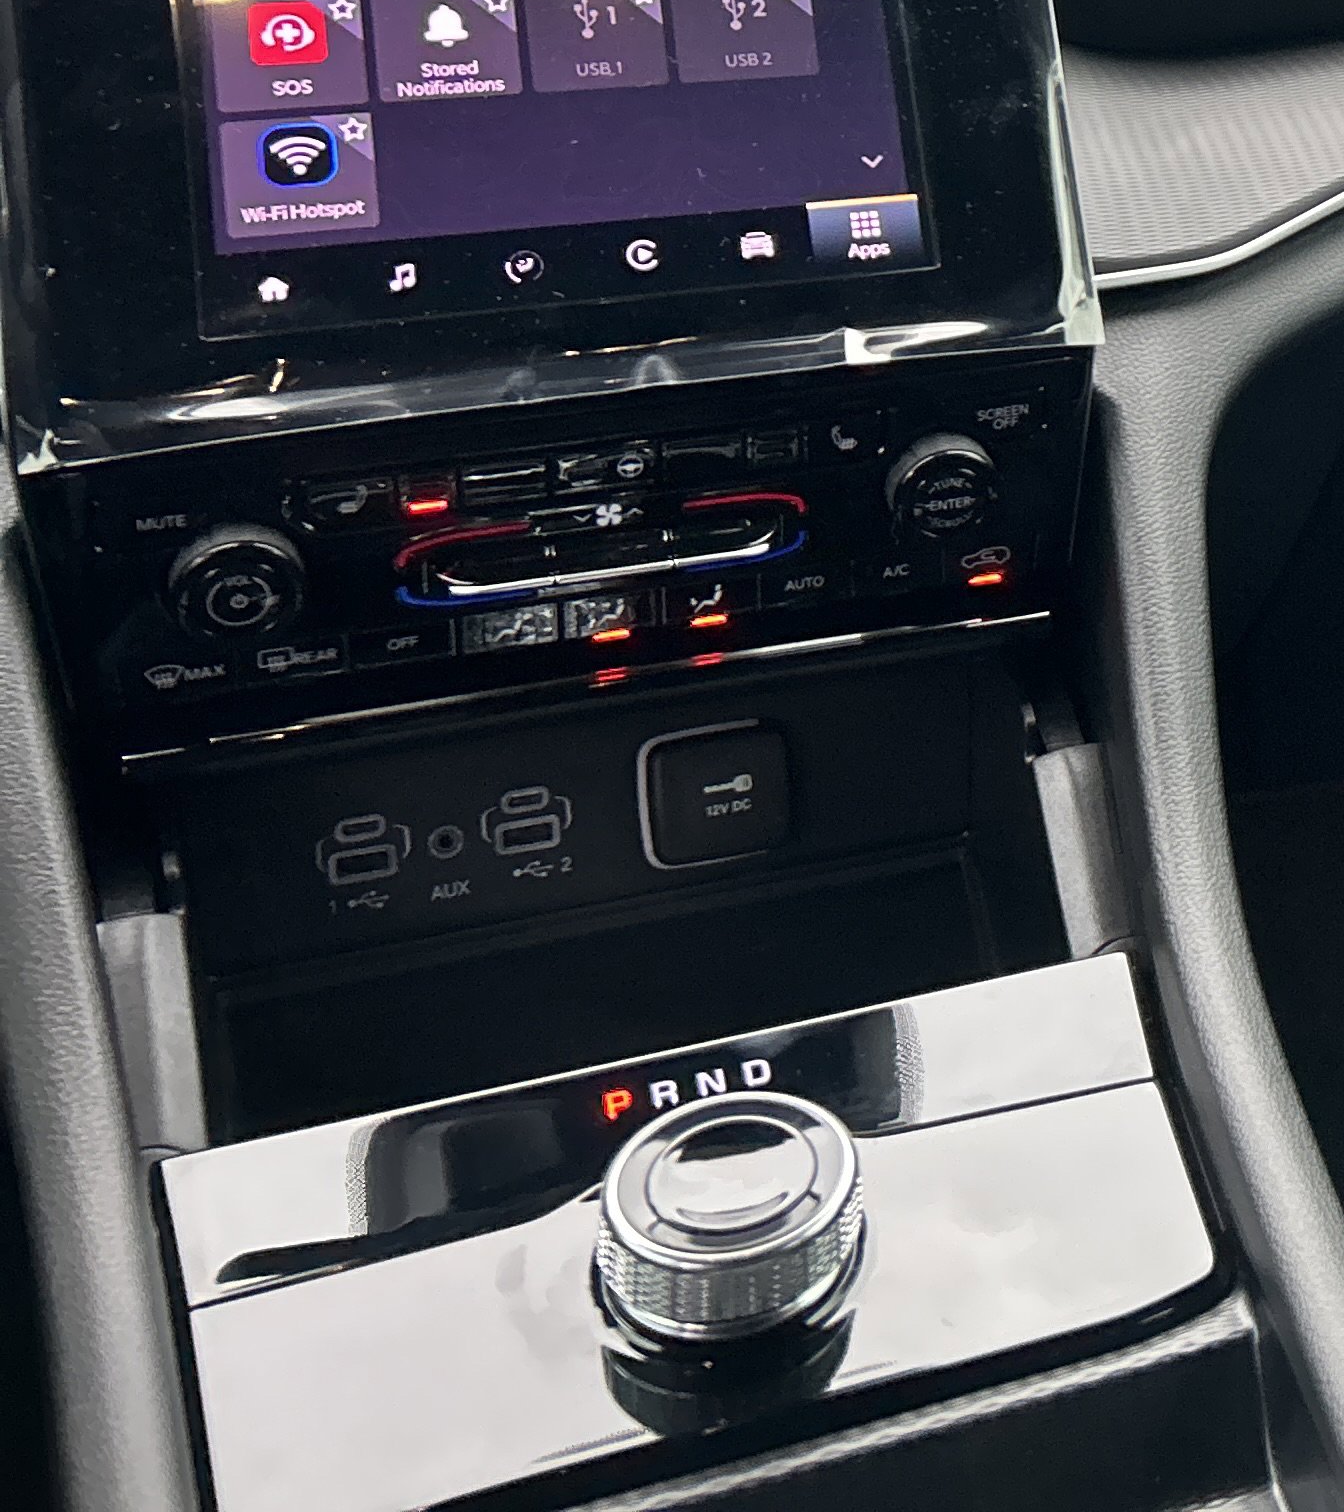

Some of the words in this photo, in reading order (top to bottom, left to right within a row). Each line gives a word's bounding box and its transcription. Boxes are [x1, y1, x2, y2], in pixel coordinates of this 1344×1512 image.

[420, 59, 480, 78] Stored
[575, 60, 612, 76] USB
[724, 52, 759, 69] USB
[760, 51, 773, 67] 2
[271, 79, 314, 98] SOS
[396, 77, 507, 99] Notifications
[240, 204, 290, 224] Wi-Fi
[290, 198, 366, 223] Hotspot
[847, 241, 892, 262] Apps
[975, 402, 1031, 424] SCREEN
[991, 413, 1020, 431] OFF
[928, 495, 973, 513] ENTER
[136, 513, 189, 533] MUTE
[881, 563, 911, 580] A/C
[784, 574, 826, 592] AUTO
[386, 633, 422, 651] OFF
[292, 647, 338, 666] REAR
[183, 663, 226, 683] MAX
[705, 799, 733, 818] 12V
[731, 796, 752, 814] DC
[560, 856, 574, 873] 2
[430, 879, 471, 902] AUX
[329, 898, 338, 915] 1
[601, 1086, 634, 1122] P
[649, 1080, 681, 1110] R
[695, 1067, 728, 1096] N
[741, 1057, 773, 1088] D
